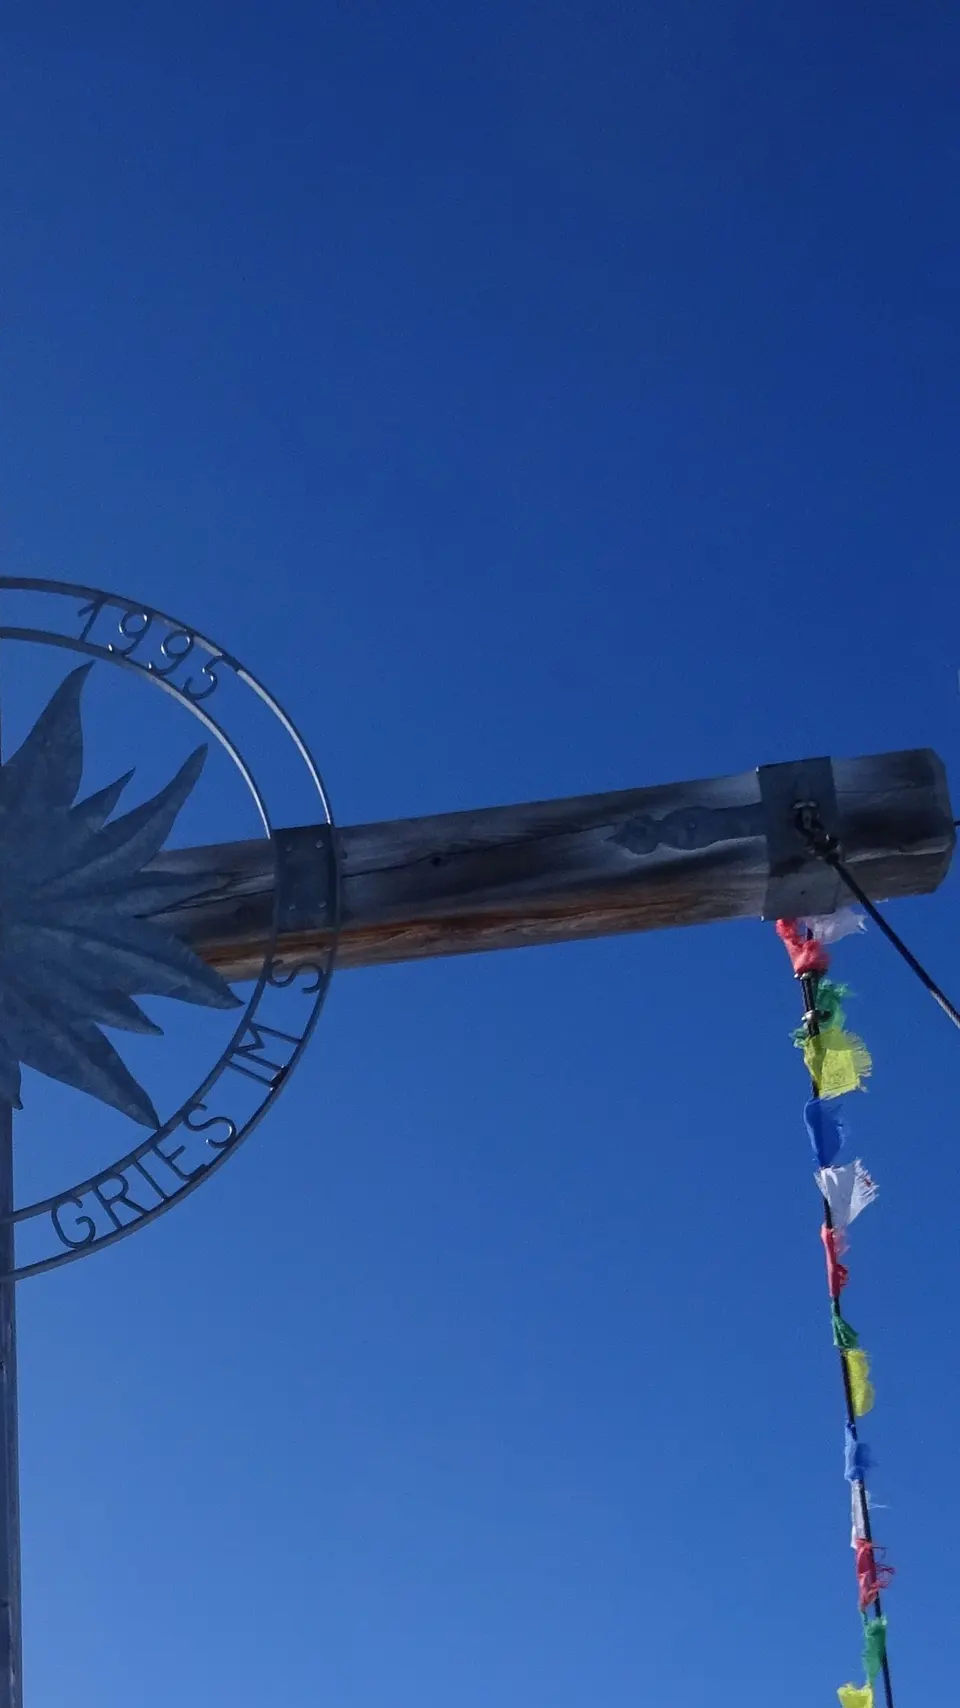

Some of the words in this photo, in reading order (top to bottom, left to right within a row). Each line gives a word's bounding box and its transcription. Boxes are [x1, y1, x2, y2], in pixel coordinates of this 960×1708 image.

[77, 599, 219, 701] 1995
[50, 1100, 237, 1250] GRIES
[224, 1020, 304, 1090] IM
[266, 958, 328, 994] S
